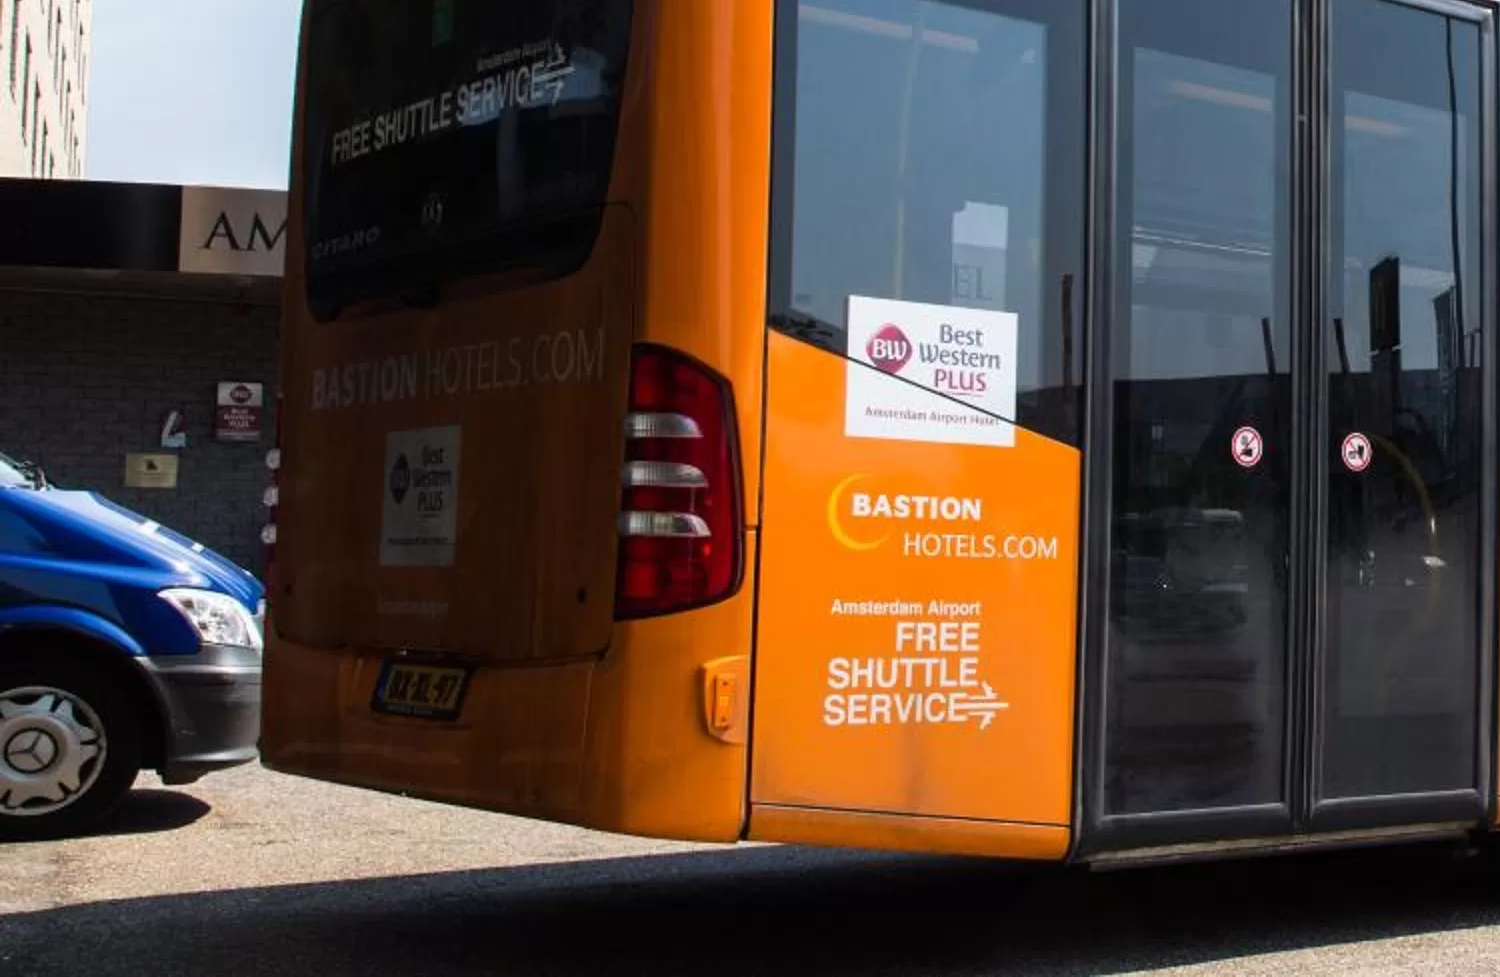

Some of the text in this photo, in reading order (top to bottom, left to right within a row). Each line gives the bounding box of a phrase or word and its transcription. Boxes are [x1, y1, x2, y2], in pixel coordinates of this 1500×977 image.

[331, 62, 545, 165] FREE SHUTTLE SERVICE
[312, 226, 381, 259] CITARO
[939, 323, 984, 348] Best
[310, 325, 607, 412] BASTION HOTELS.COM
[871, 338, 1002, 370] BW Western
[934, 368, 987, 392] PLUS
[865, 406, 928, 422] Amsterdam
[929, 409, 968, 426] Airport
[852, 493, 982, 521] BASTION
[903, 532, 1058, 561] HOTELS.COM
[830, 598, 982, 620] Amsterdam Airport
[895, 623, 980, 653] FREE
[828, 656, 979, 688] SHUTTLE
[823, 690, 972, 725] SERVICE
